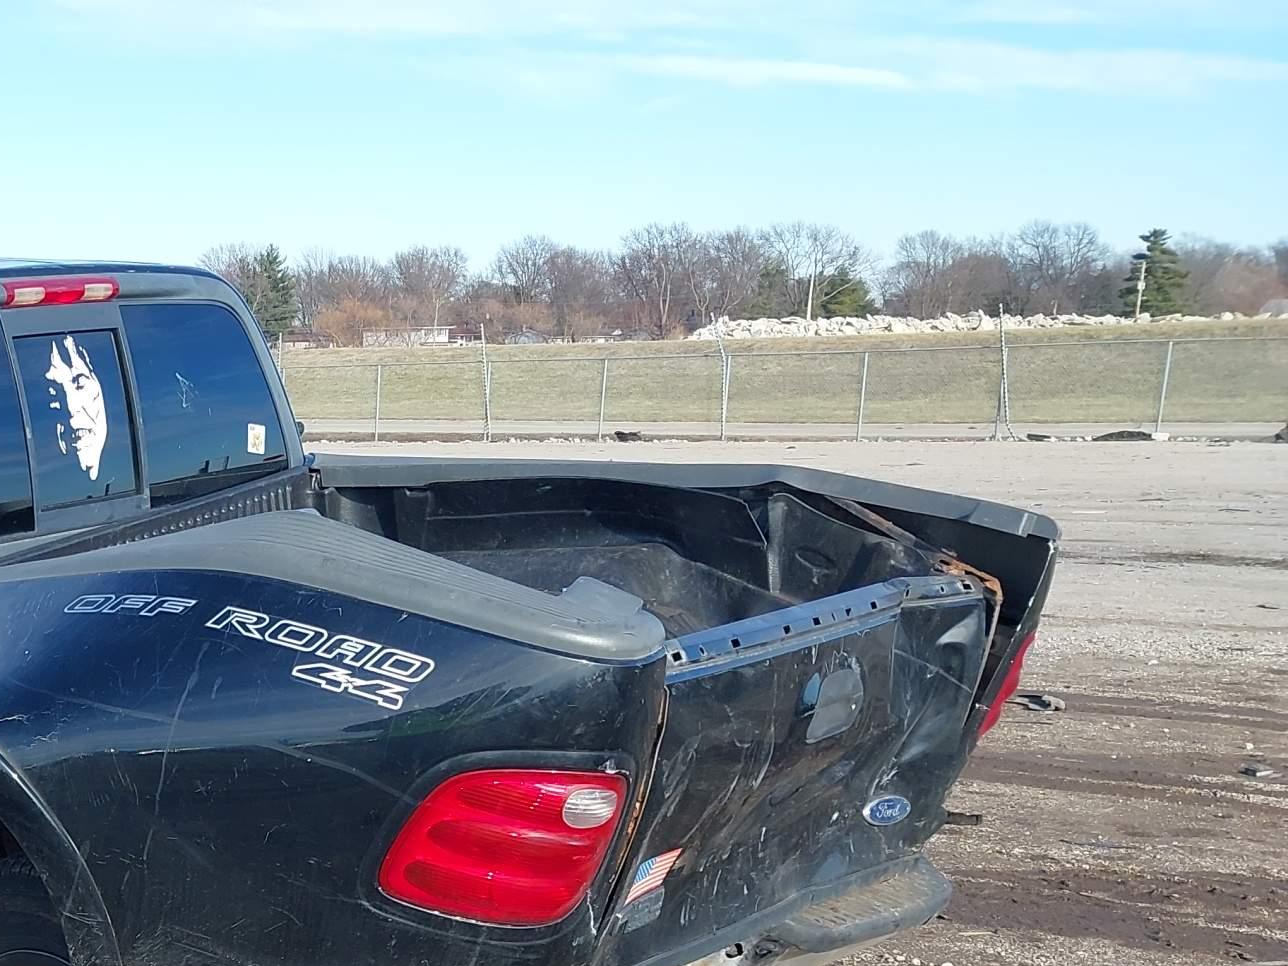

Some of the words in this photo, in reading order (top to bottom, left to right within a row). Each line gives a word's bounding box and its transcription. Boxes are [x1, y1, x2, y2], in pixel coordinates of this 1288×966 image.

[64, 594, 199, 617] OFF
[205, 606, 436, 683] ROAD
[876, 802, 901, 819] Ford
